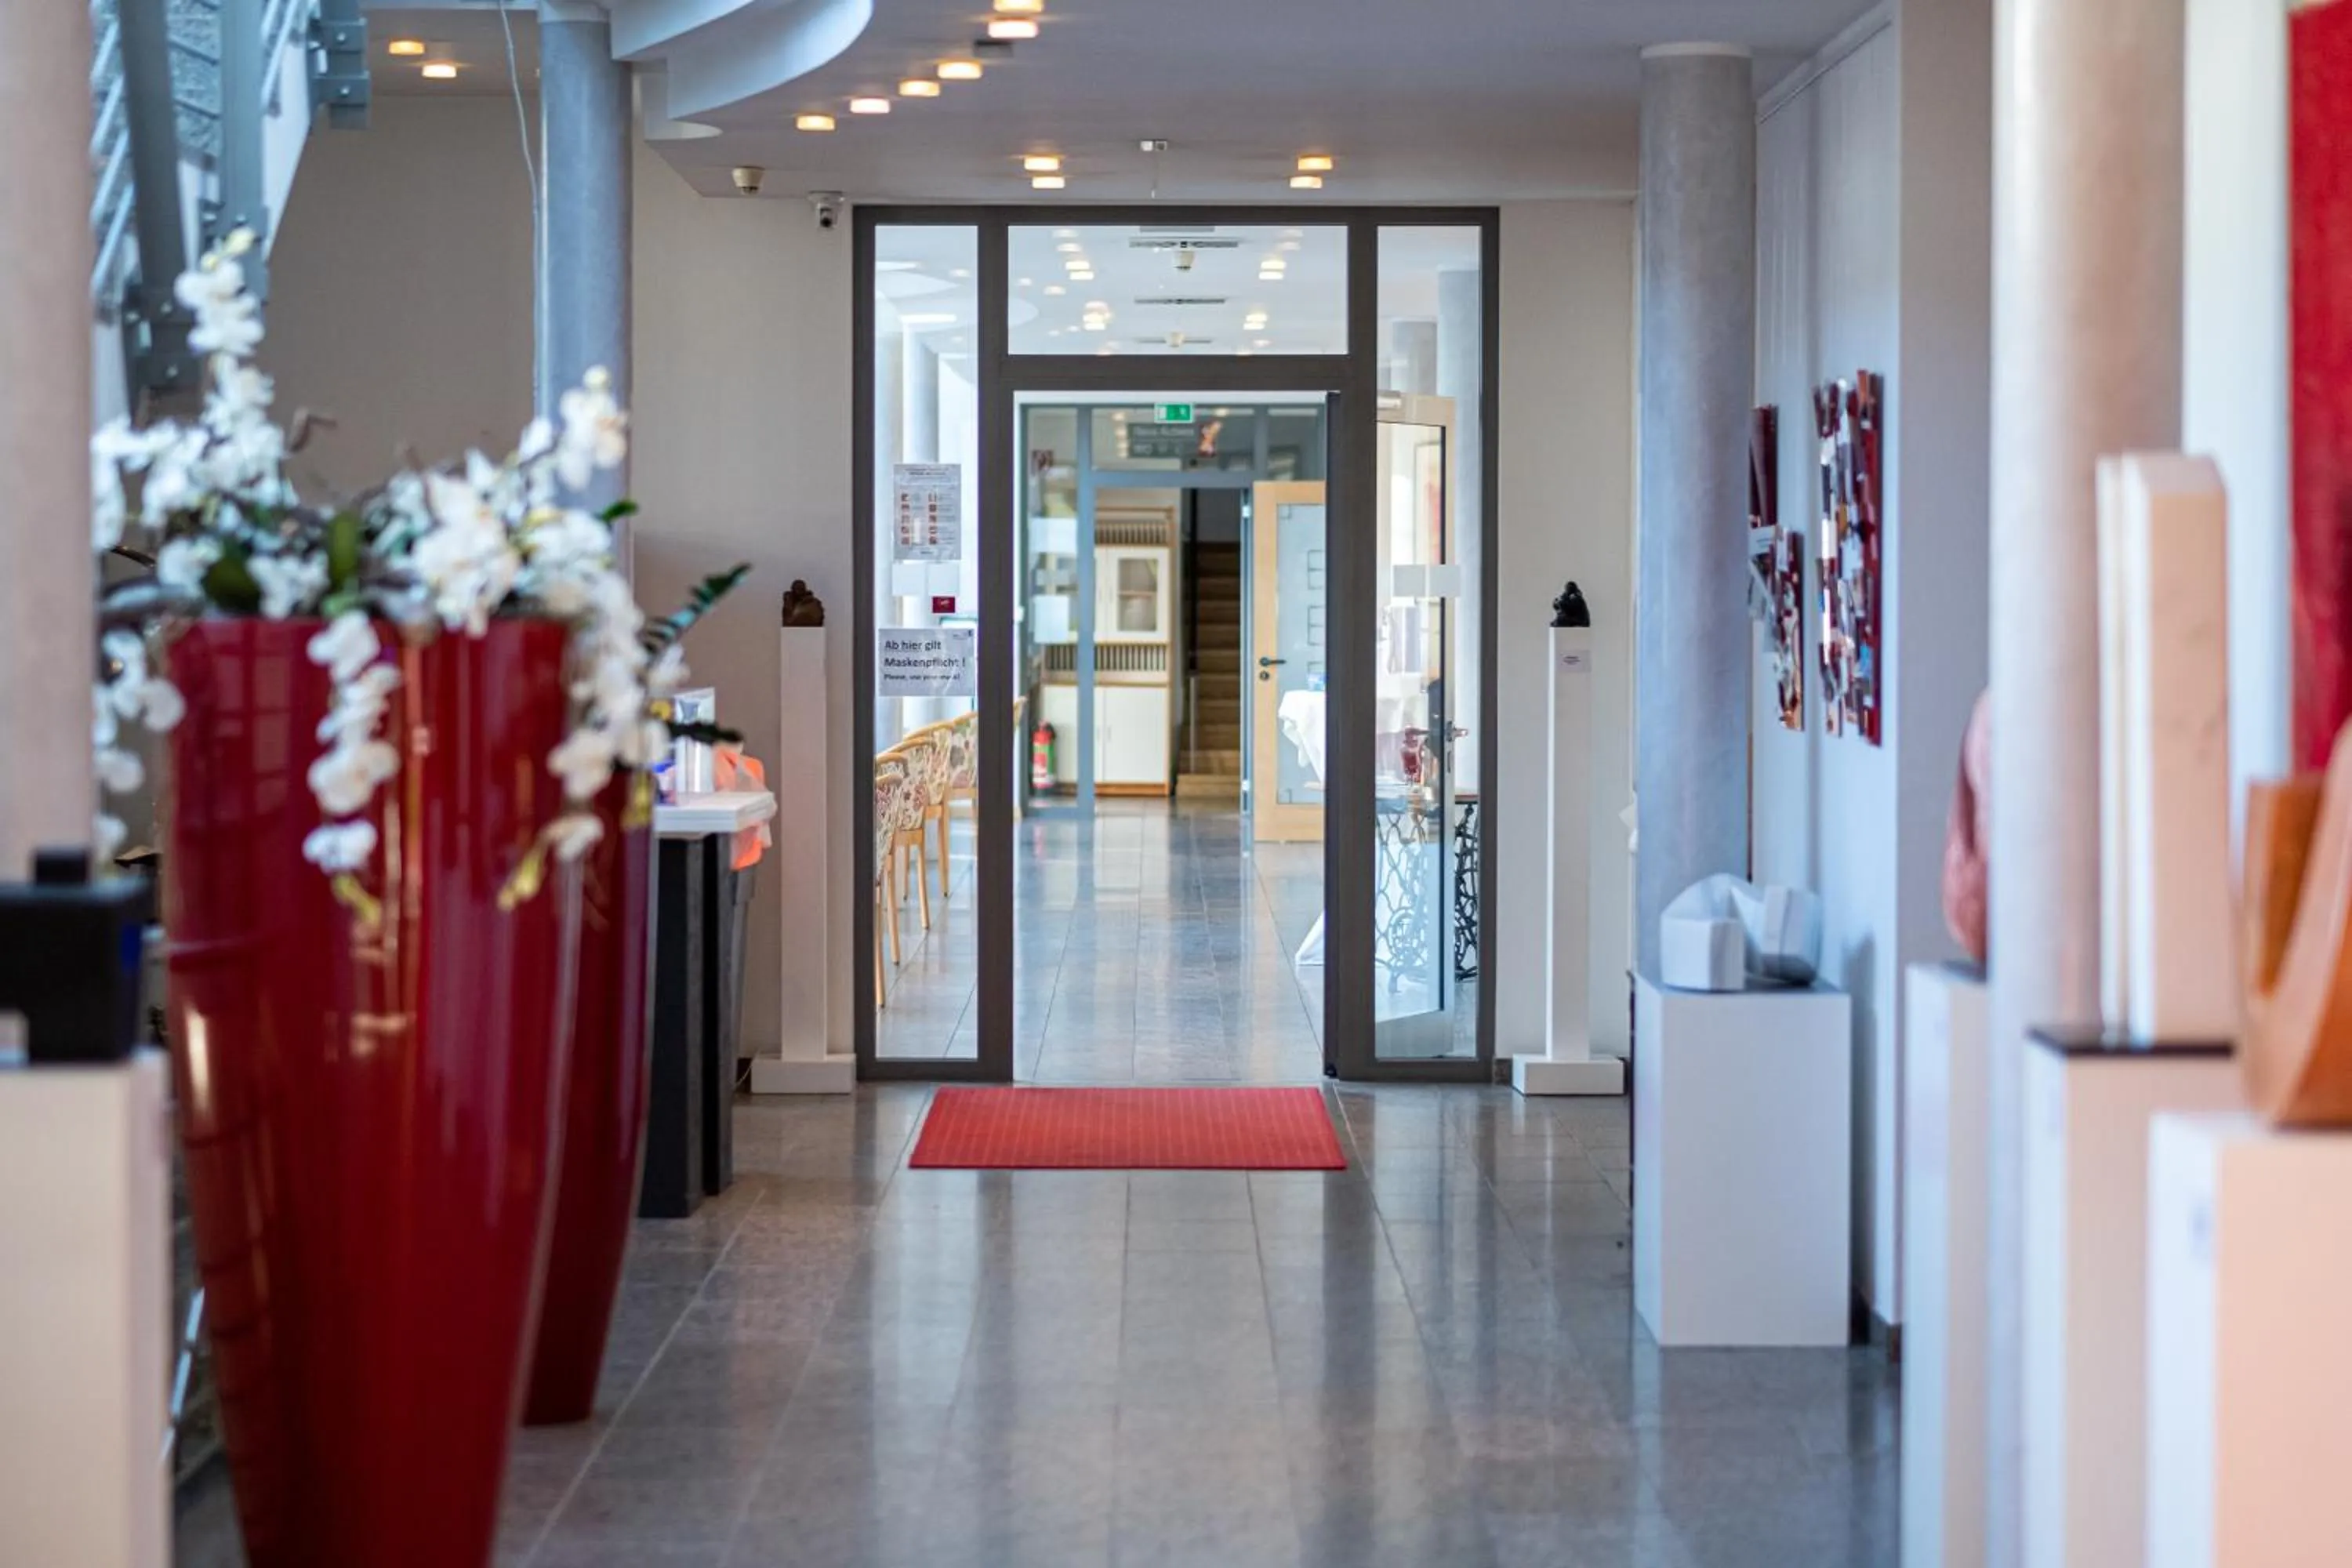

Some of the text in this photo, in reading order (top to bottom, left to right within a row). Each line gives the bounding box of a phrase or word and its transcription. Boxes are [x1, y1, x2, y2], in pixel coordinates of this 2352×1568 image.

[885, 640, 942, 652] Ab hier gilt
[885, 658, 959, 668] Maskenpfcht
